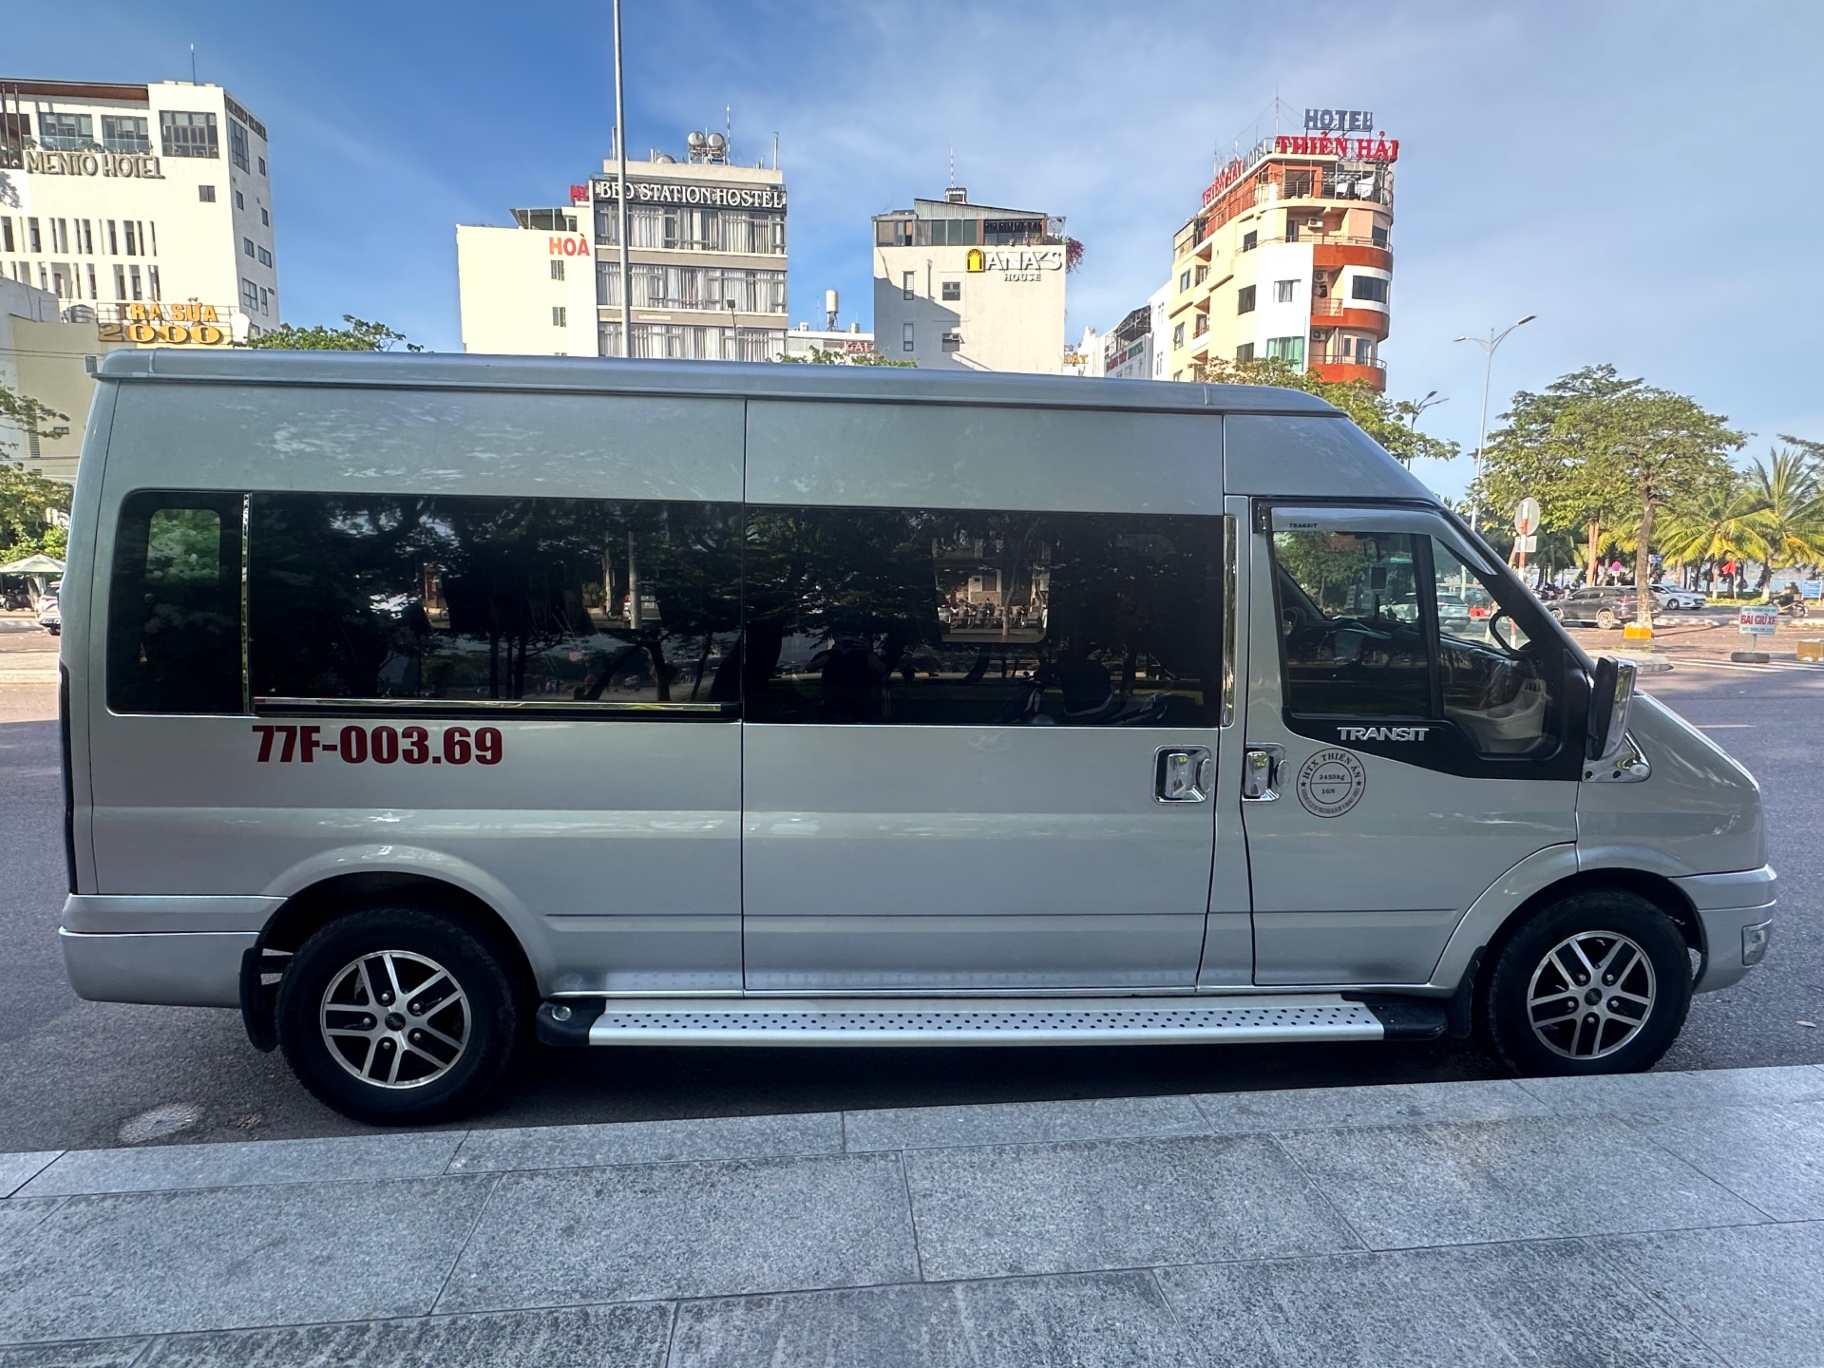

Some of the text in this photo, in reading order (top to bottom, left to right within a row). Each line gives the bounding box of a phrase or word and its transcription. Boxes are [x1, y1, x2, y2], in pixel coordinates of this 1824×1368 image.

[1303, 108, 1373, 130] HOTEL
[1355, 130, 1400, 161] HẢI
[25, 150, 165, 180] MENTO HOTEL
[640, 183, 711, 205] STATION
[716, 188, 783, 209] HOSTEL
[549, 233, 591, 257] HOÀ
[1003, 273, 1042, 282] HOUSE
[98, 322, 222, 344] 2000
[251, 725, 503, 765] 77F-003.69
[1336, 727, 1430, 741] TRANSIT
[1302, 758, 1320, 780] HTX
